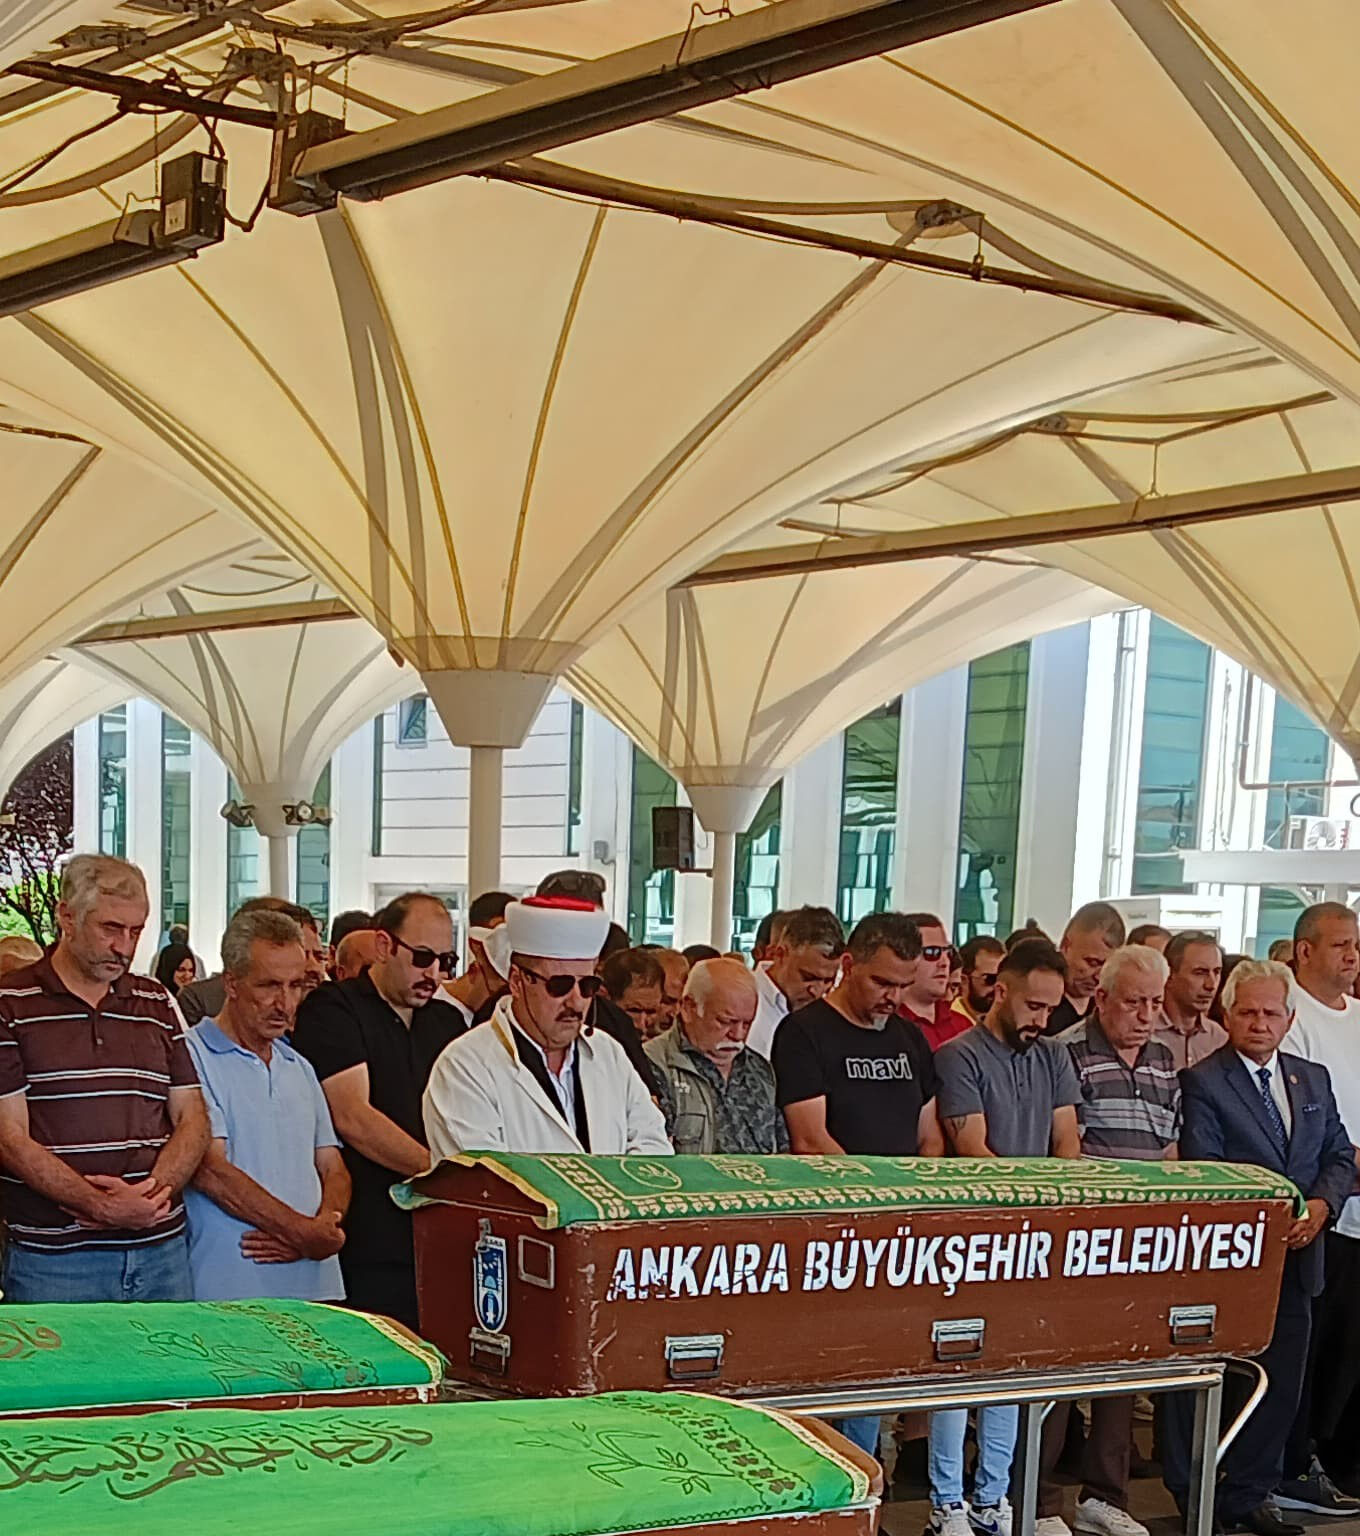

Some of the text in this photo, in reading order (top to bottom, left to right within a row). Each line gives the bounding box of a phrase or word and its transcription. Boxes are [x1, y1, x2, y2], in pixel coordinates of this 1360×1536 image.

[845, 1053, 913, 1080] mavi
[606, 1210, 1267, 1302] ANKARA BÜYÜKŞEHİR BELEDİYESİ
